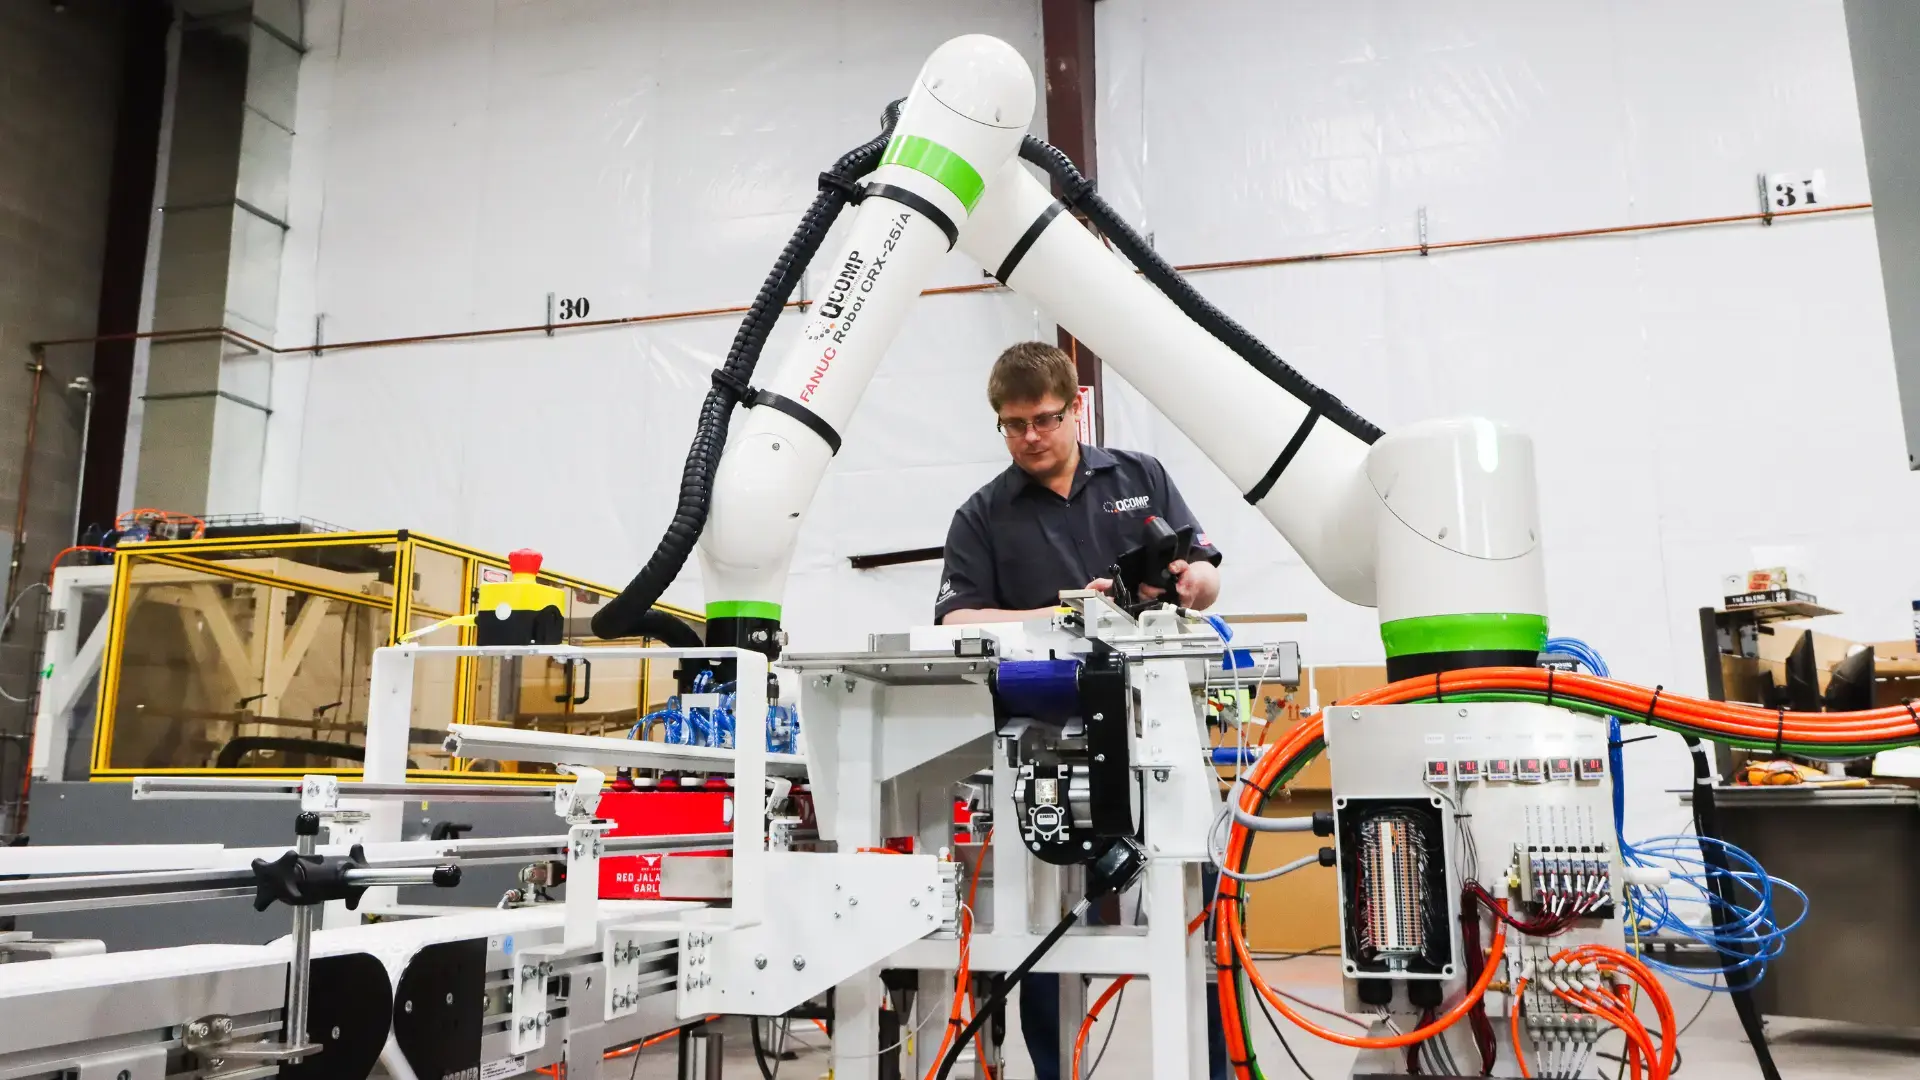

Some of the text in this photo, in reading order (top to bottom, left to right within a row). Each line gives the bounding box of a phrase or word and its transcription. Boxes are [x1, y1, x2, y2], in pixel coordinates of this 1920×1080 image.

[1776, 180, 1817, 207] 31
[819, 250, 864, 319] QCOMP
[559, 297, 590, 320] 30
[799, 212, 912, 403] FANUC Robot CRX-25iA
[1115, 495, 1150, 512] QCOMP
[616, 872, 634, 882] RED
